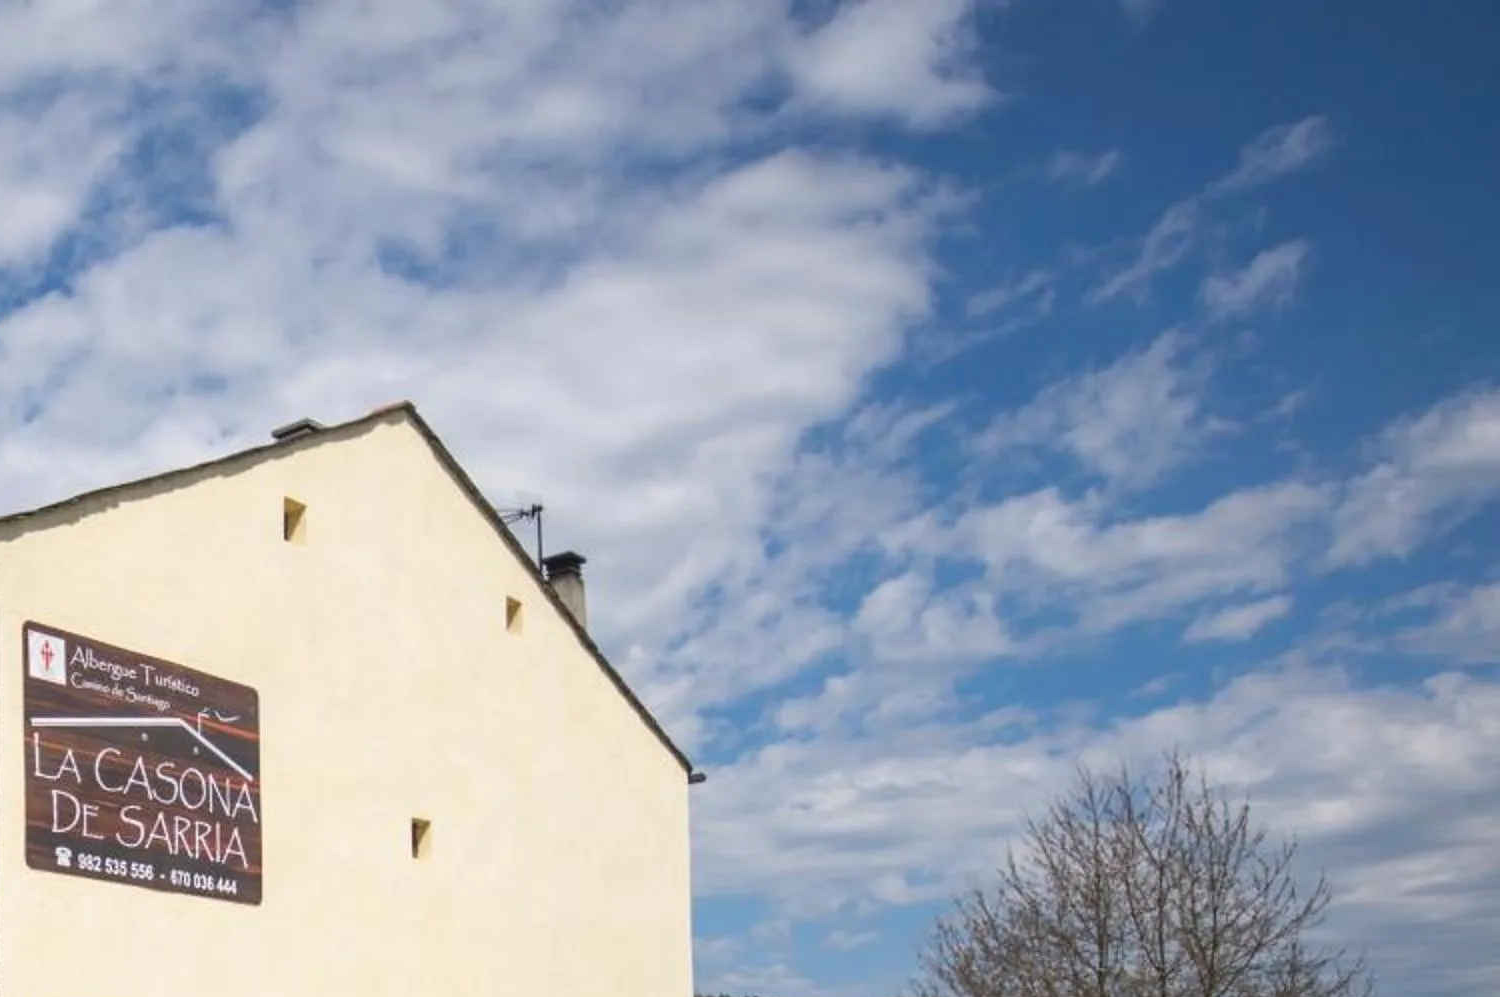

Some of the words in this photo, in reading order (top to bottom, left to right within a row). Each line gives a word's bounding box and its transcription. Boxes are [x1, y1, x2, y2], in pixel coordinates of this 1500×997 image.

[70, 646, 137, 681] Albergue
[33, 732, 82, 783] LA
[95, 747, 258, 823] CASONA
[116, 804, 249, 869] SARRIA
[77, 853, 101, 872] 982
[105, 856, 128, 876] 535
[217, 877, 237, 894] 444
